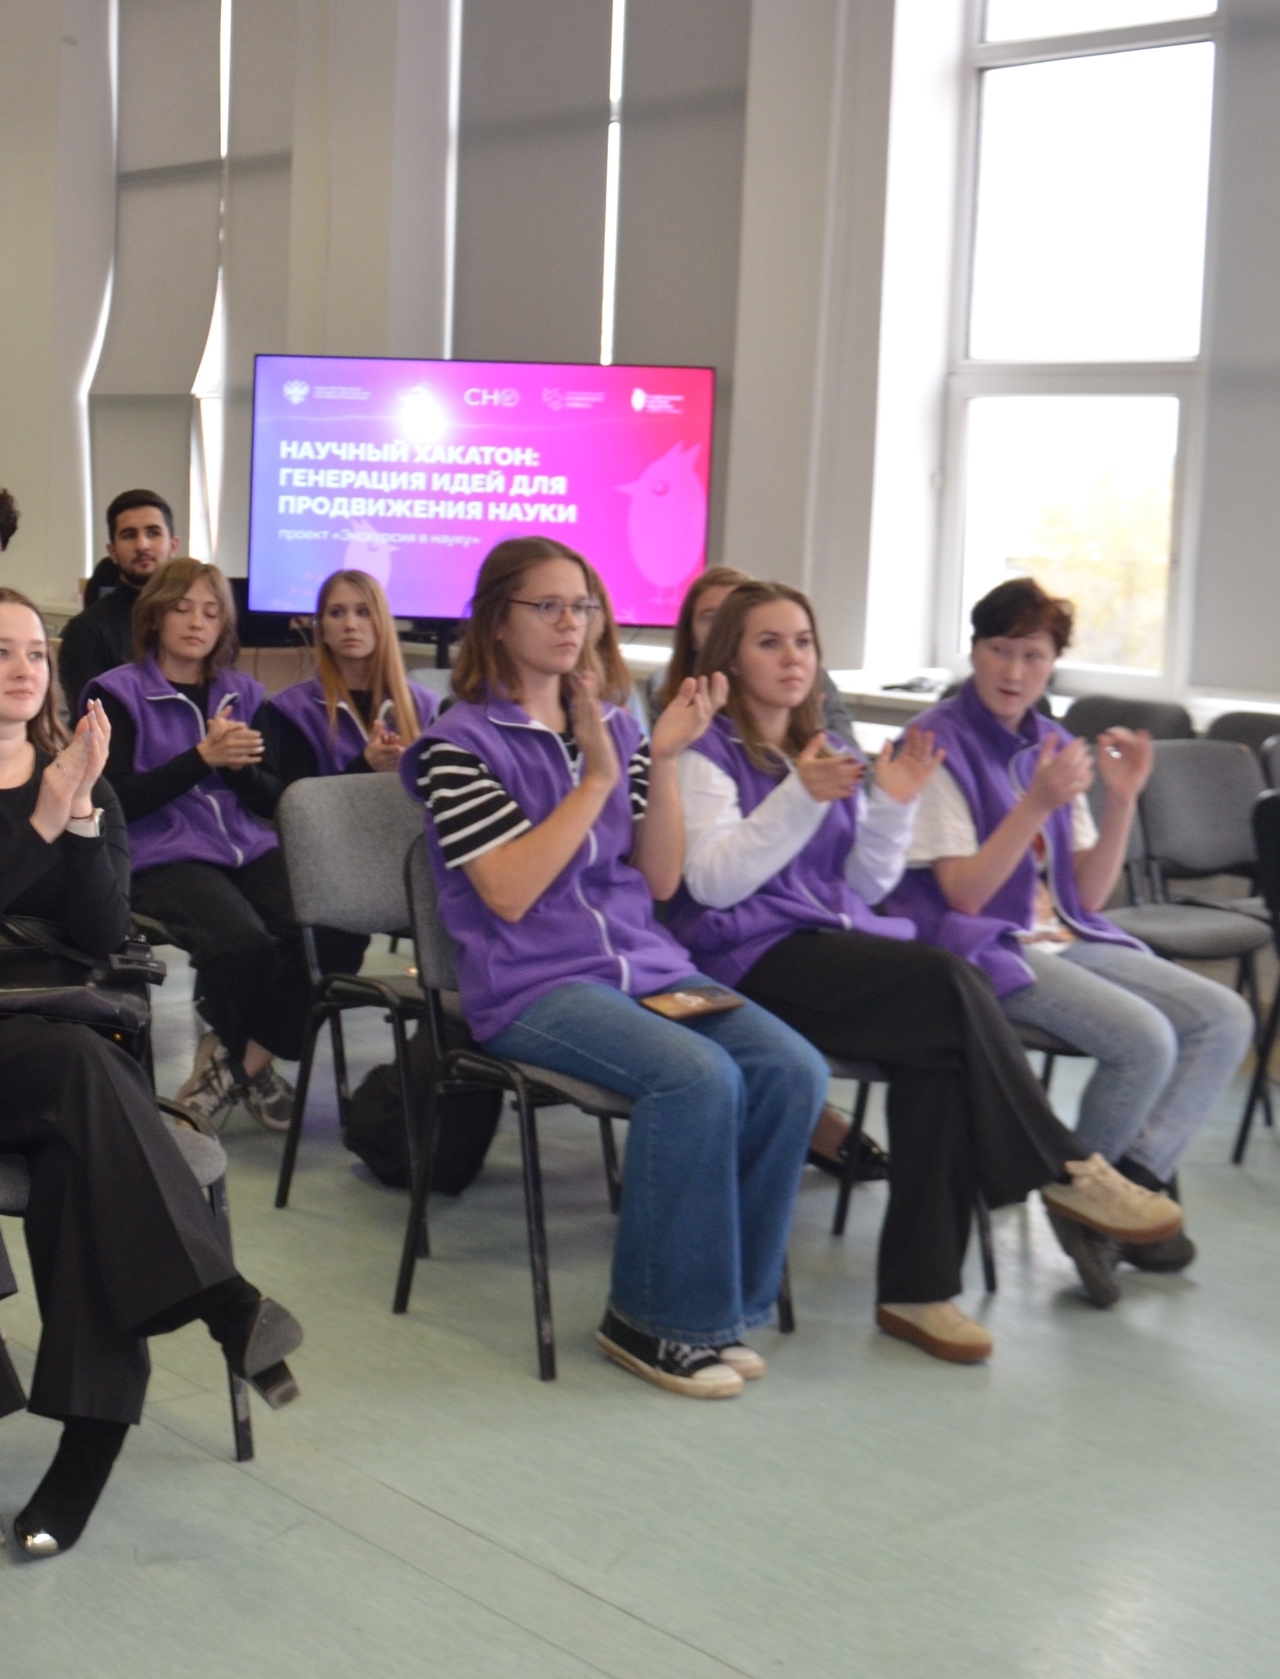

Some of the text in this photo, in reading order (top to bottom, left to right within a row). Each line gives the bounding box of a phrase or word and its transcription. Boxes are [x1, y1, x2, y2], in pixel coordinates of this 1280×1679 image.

[280, 439, 540, 467] НАУЧНЫЙ ХАКАТОН:
[279, 468, 567, 497] ГЕНЕРАЦИЯ ИДЕЙ ДЛЯ
[278, 495, 577, 523] ПРОДВИЖЕНИЯ НАУКИ
[278, 530, 329, 541] проект
